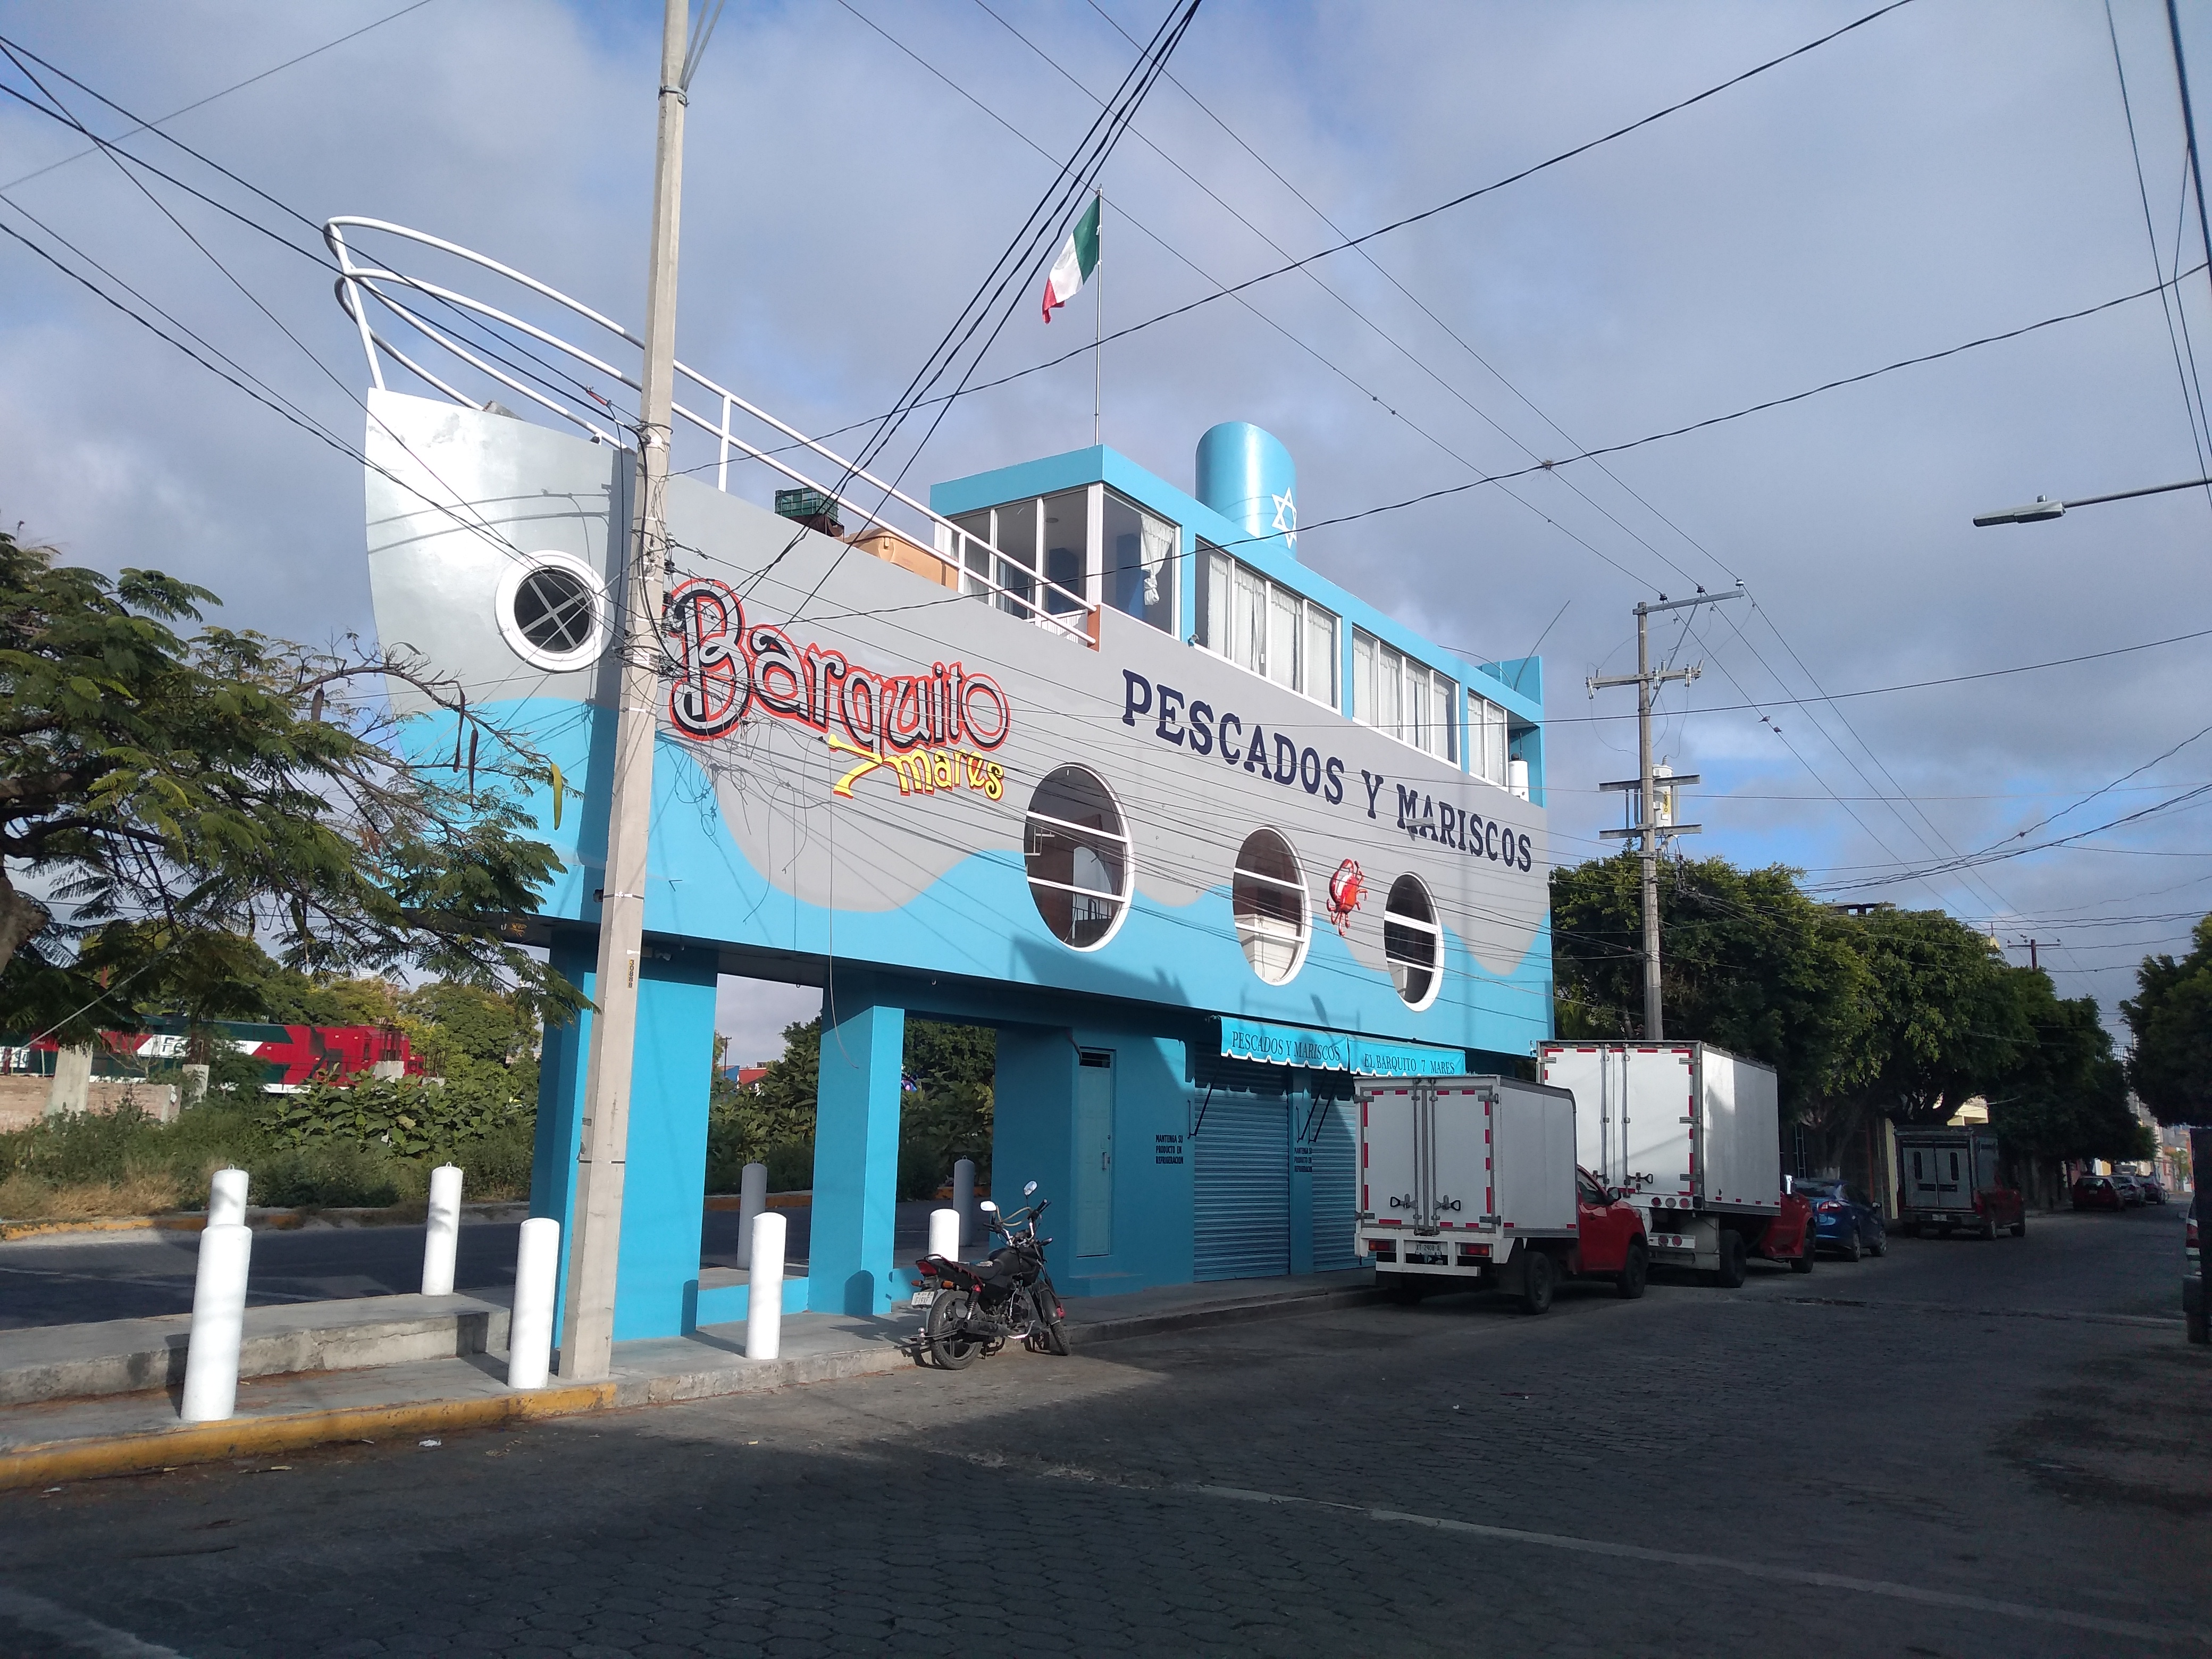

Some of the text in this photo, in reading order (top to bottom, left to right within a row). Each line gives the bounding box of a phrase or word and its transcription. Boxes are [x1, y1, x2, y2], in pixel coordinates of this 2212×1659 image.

[663, 578, 1009, 754] Barquito
[828, 734, 1006, 801] 7 mares
[1121, 668, 1532, 873] PESCADOS Y MARISCOS
[1231, 1030, 1340, 1061] PESCADOS Y MARISCOS
[1364, 1053, 1455, 1075] EL BARQUITO 7 MARES
[1155, 1134, 1183, 1143] MANTENGA SU
[1155, 1145, 1182, 1154] PRODUCTO EN
[1155, 1155, 1184, 1164] REFRIGERACION
